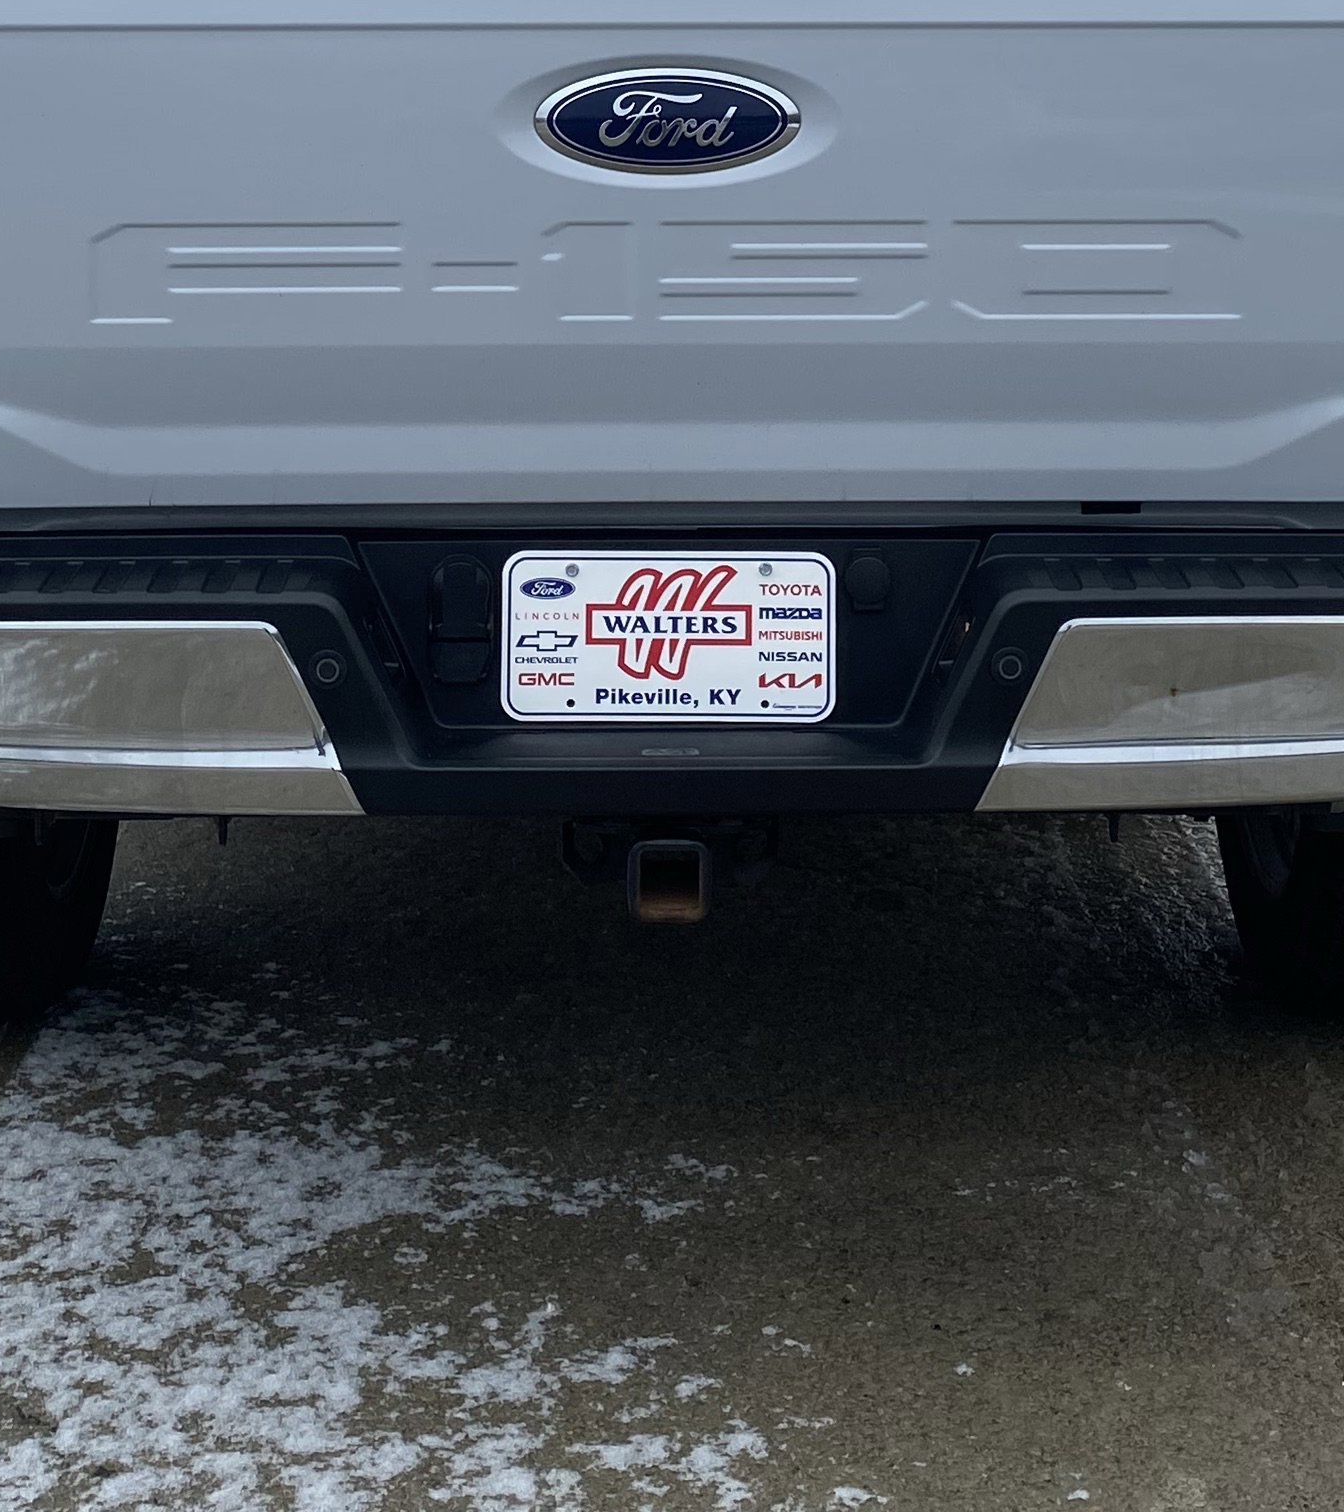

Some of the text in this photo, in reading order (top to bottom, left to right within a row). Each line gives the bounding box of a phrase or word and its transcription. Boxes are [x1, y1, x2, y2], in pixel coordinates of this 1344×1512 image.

[598, 90, 738, 148] Ford
[531, 581, 564, 596] Ford
[759, 584, 823, 596] TOYOTA
[515, 612, 580, 620] LINCOLN
[602, 615, 738, 634] WALTERS
[759, 631, 823, 641] MITSUBISHI
[515, 656, 578, 664] CHEVROLET
[758, 651, 823, 662] NISSAN
[518, 673, 575, 686] GMC
[758, 673, 823, 689] KIA
[595, 688, 742, 709] Pikeville, KY
